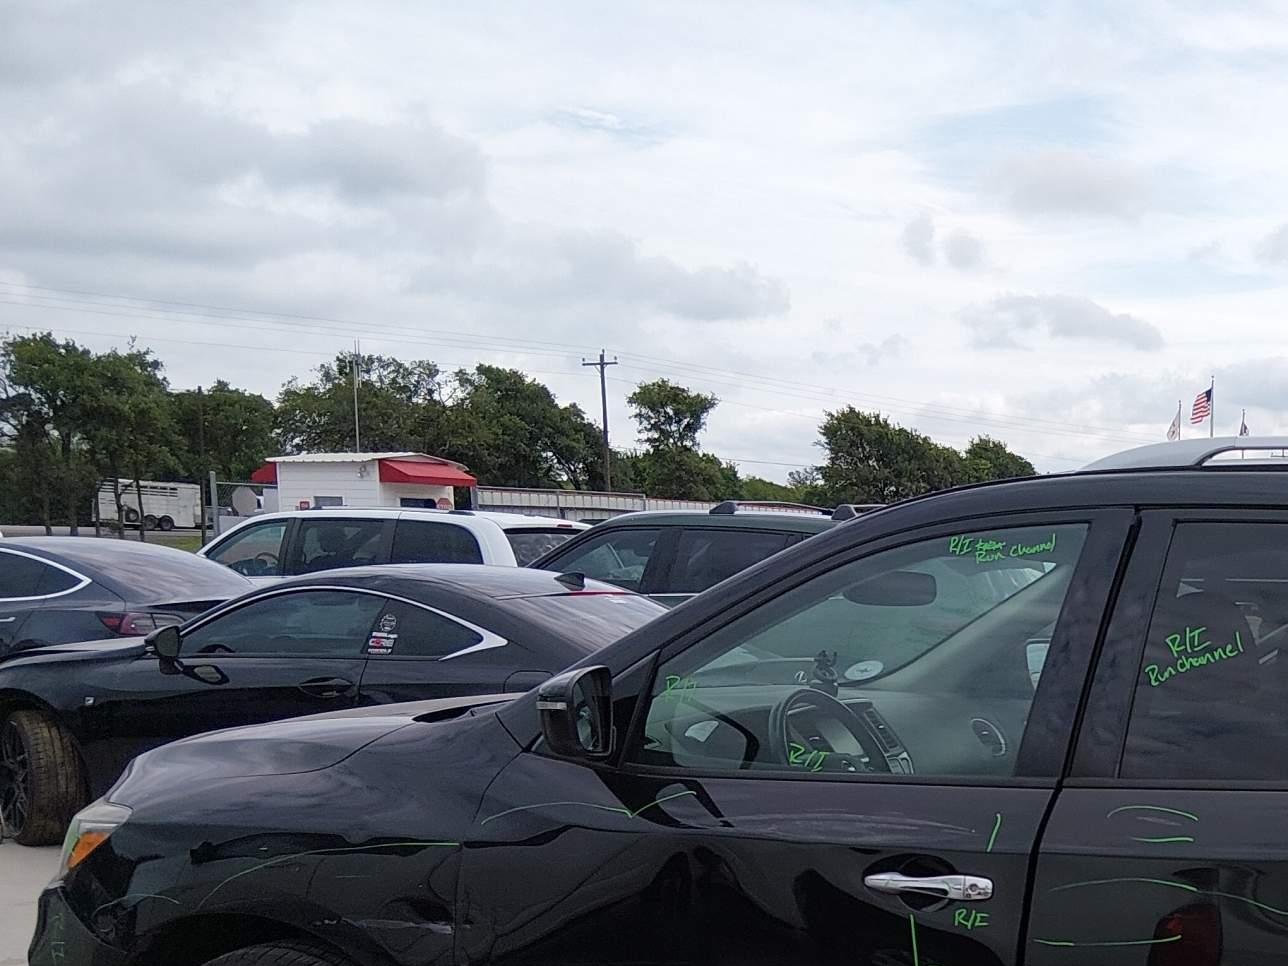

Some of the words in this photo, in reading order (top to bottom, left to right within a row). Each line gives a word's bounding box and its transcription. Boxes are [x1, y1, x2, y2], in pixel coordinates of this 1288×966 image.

[949, 536, 973, 555] R/I
[1166, 627, 1212, 657] R/I
[789, 743, 830, 772] R/I
